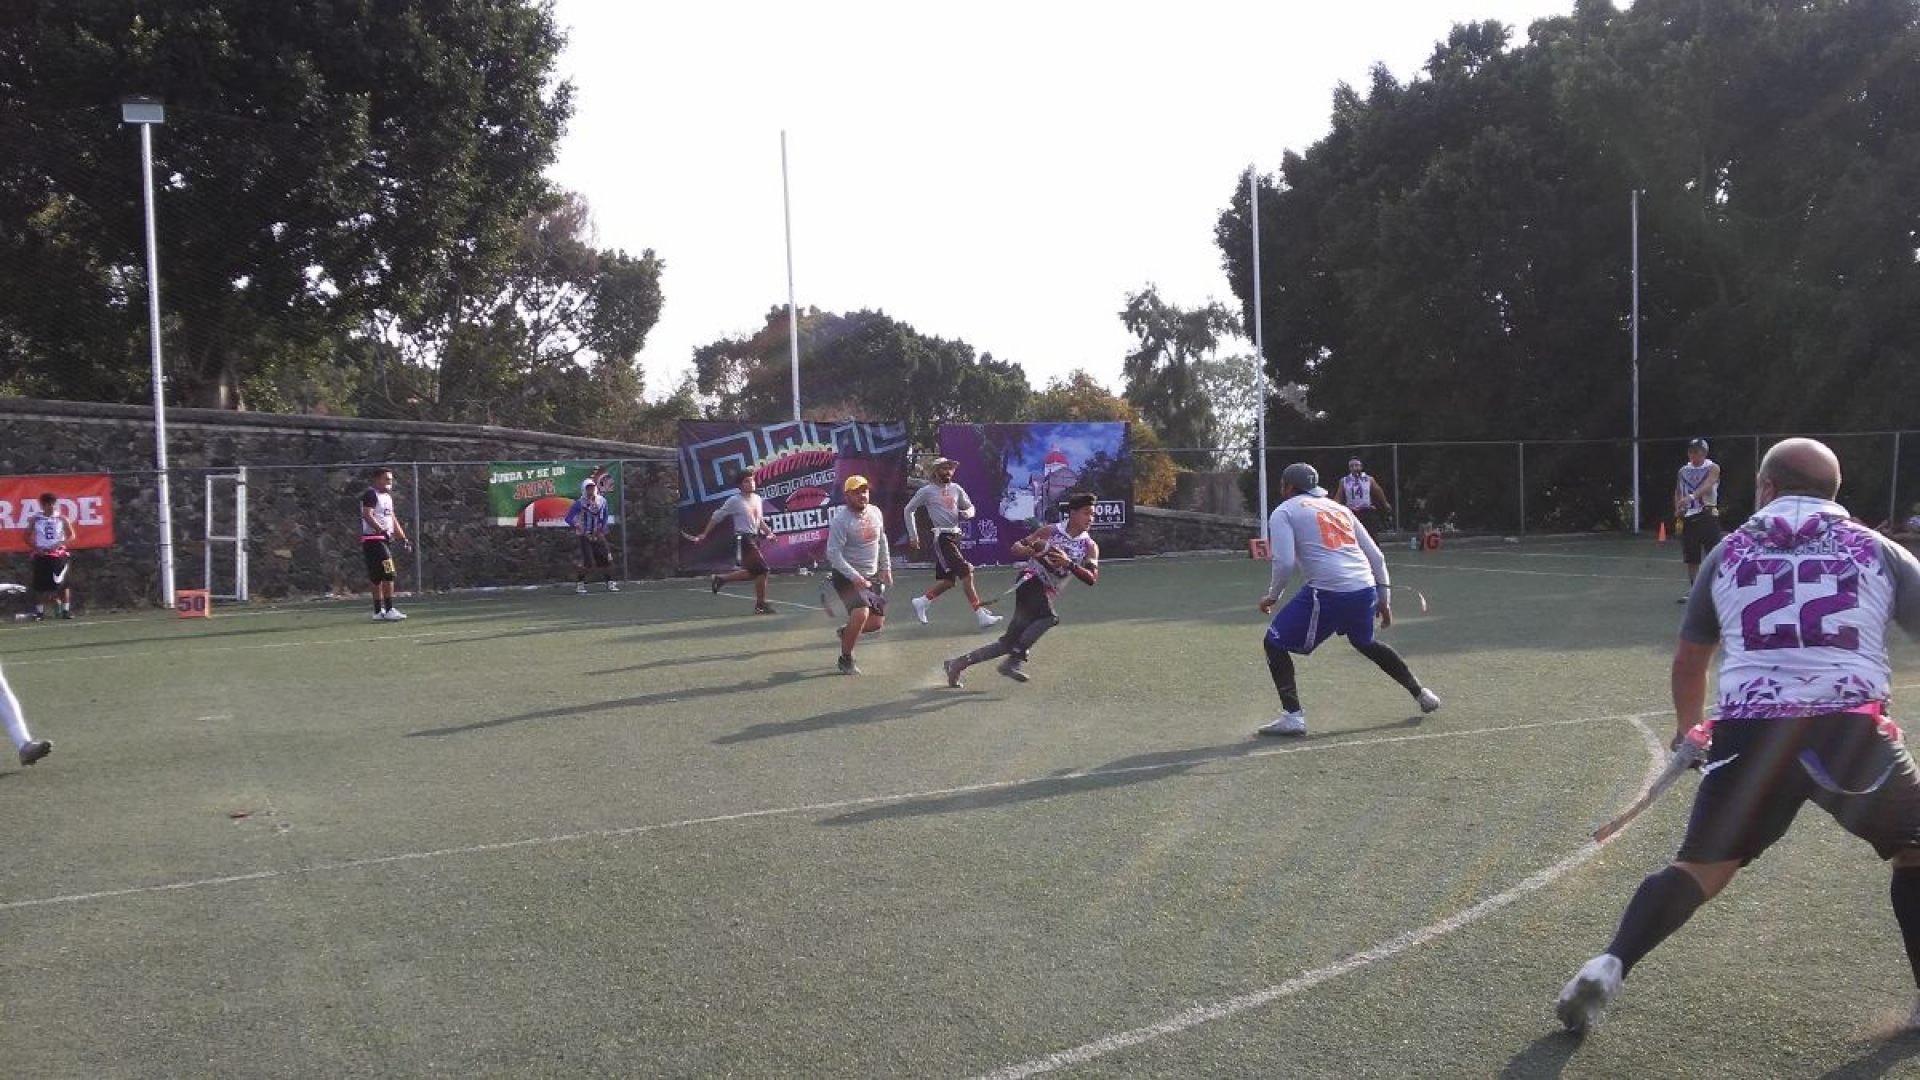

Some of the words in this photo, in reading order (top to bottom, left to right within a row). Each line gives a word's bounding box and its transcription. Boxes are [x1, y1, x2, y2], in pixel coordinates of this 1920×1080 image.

[526, 469, 535, 479] Y
[537, 468, 550, 478] SE
[1351, 484, 1363, 500] 14
[178, 596, 206, 611] 50
[1737, 559, 1859, 651] 22
